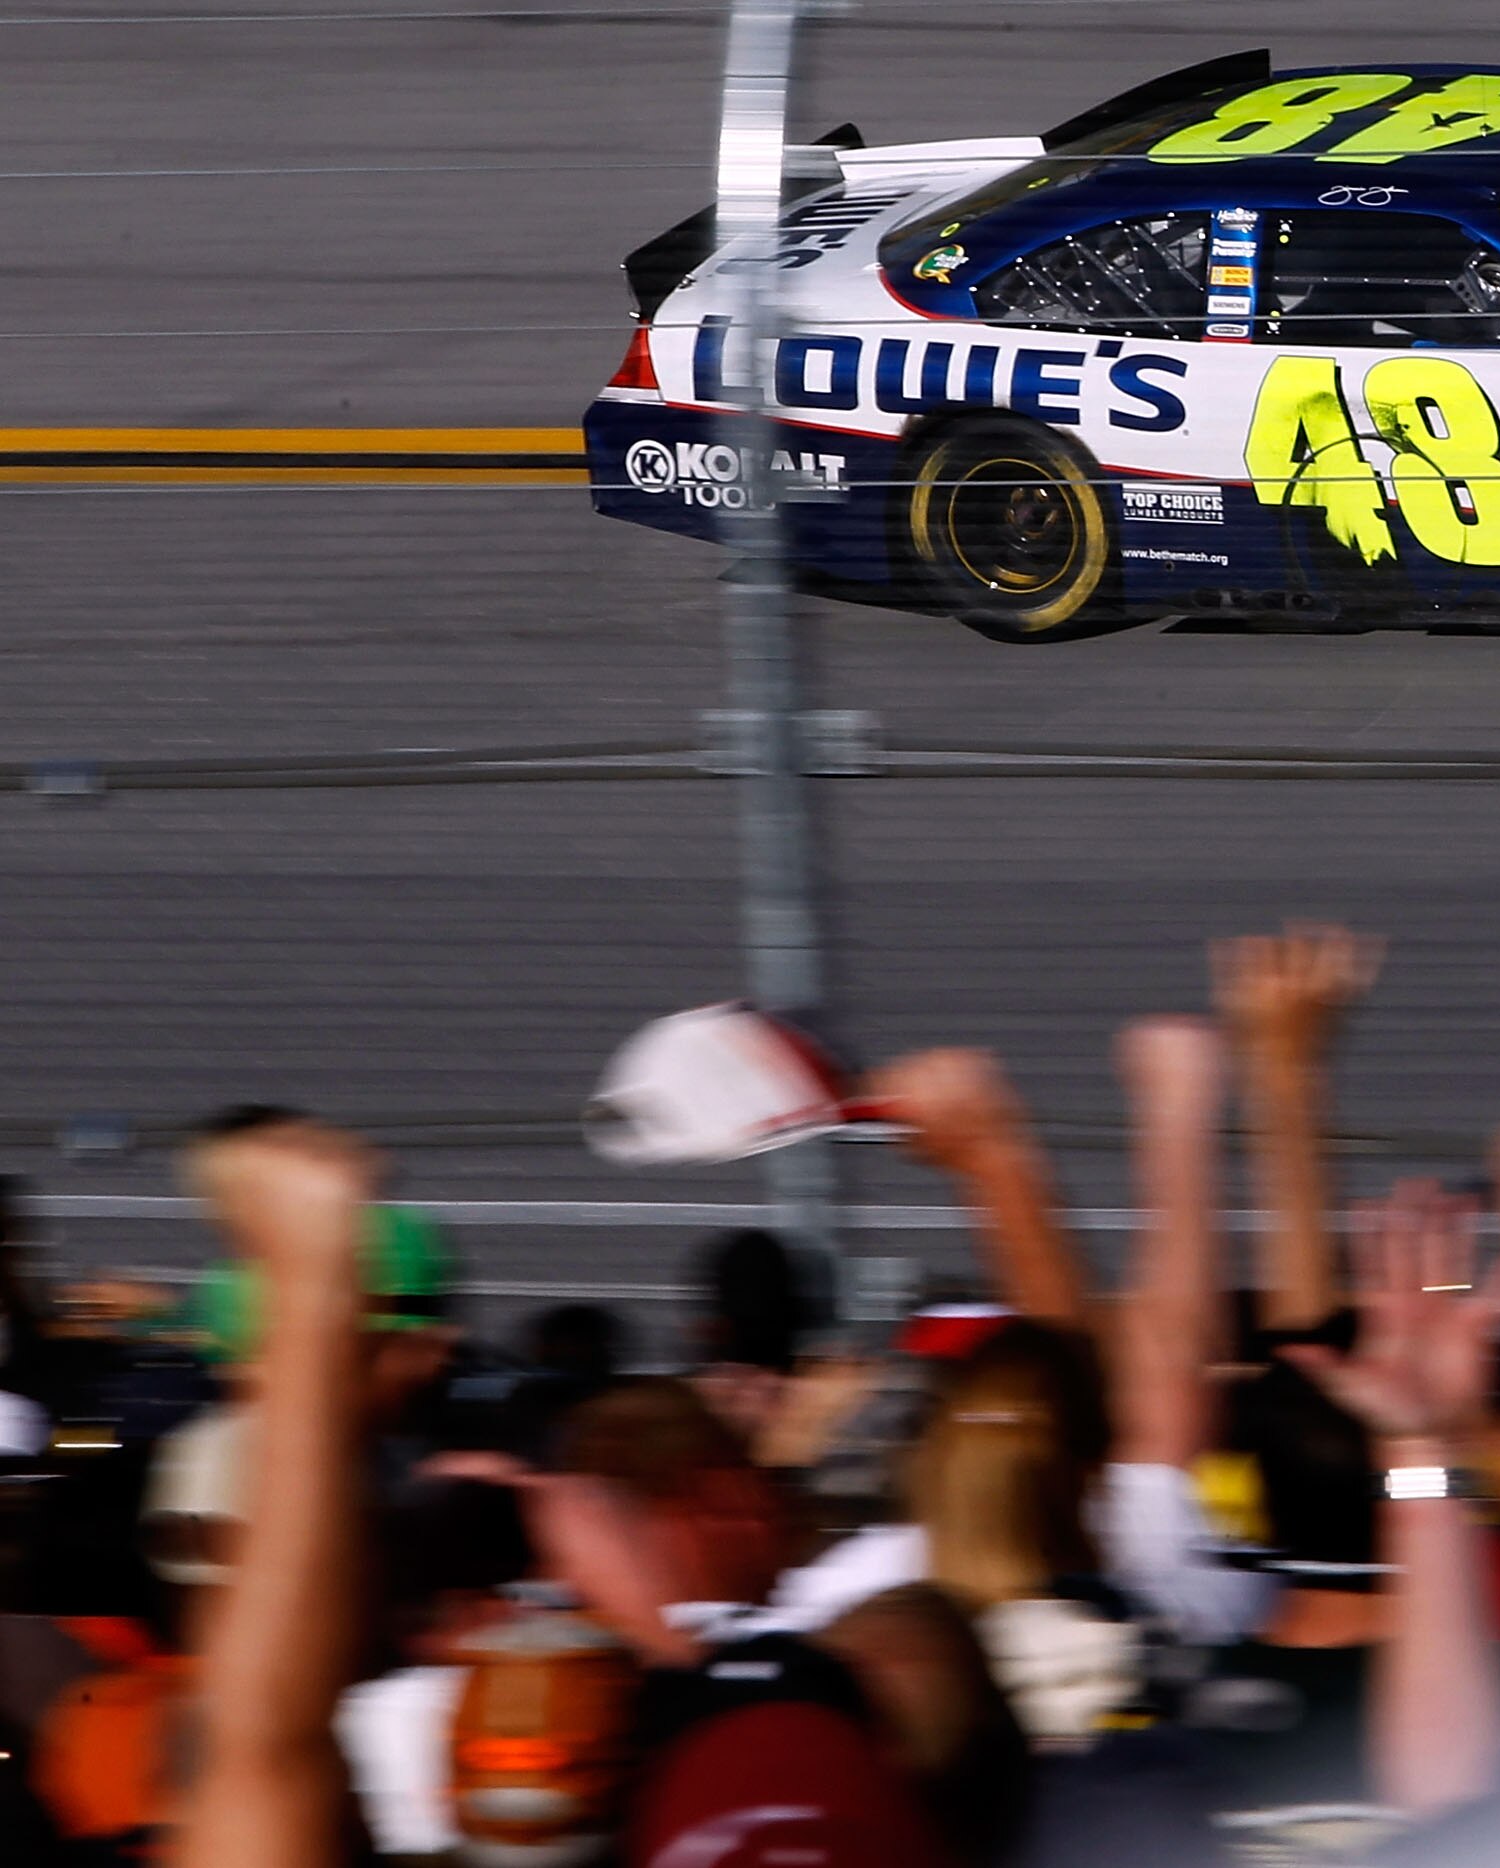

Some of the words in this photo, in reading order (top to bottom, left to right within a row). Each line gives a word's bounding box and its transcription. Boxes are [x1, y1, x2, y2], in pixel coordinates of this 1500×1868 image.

[693, 313, 1188, 433] LOWE'S
[1122, 492, 1159, 508] TOP
[1160, 494, 1224, 511] CHOICE
[1123, 508, 1165, 518] LUMBER
[1121, 548, 1229, 567] www.bethematch.org
